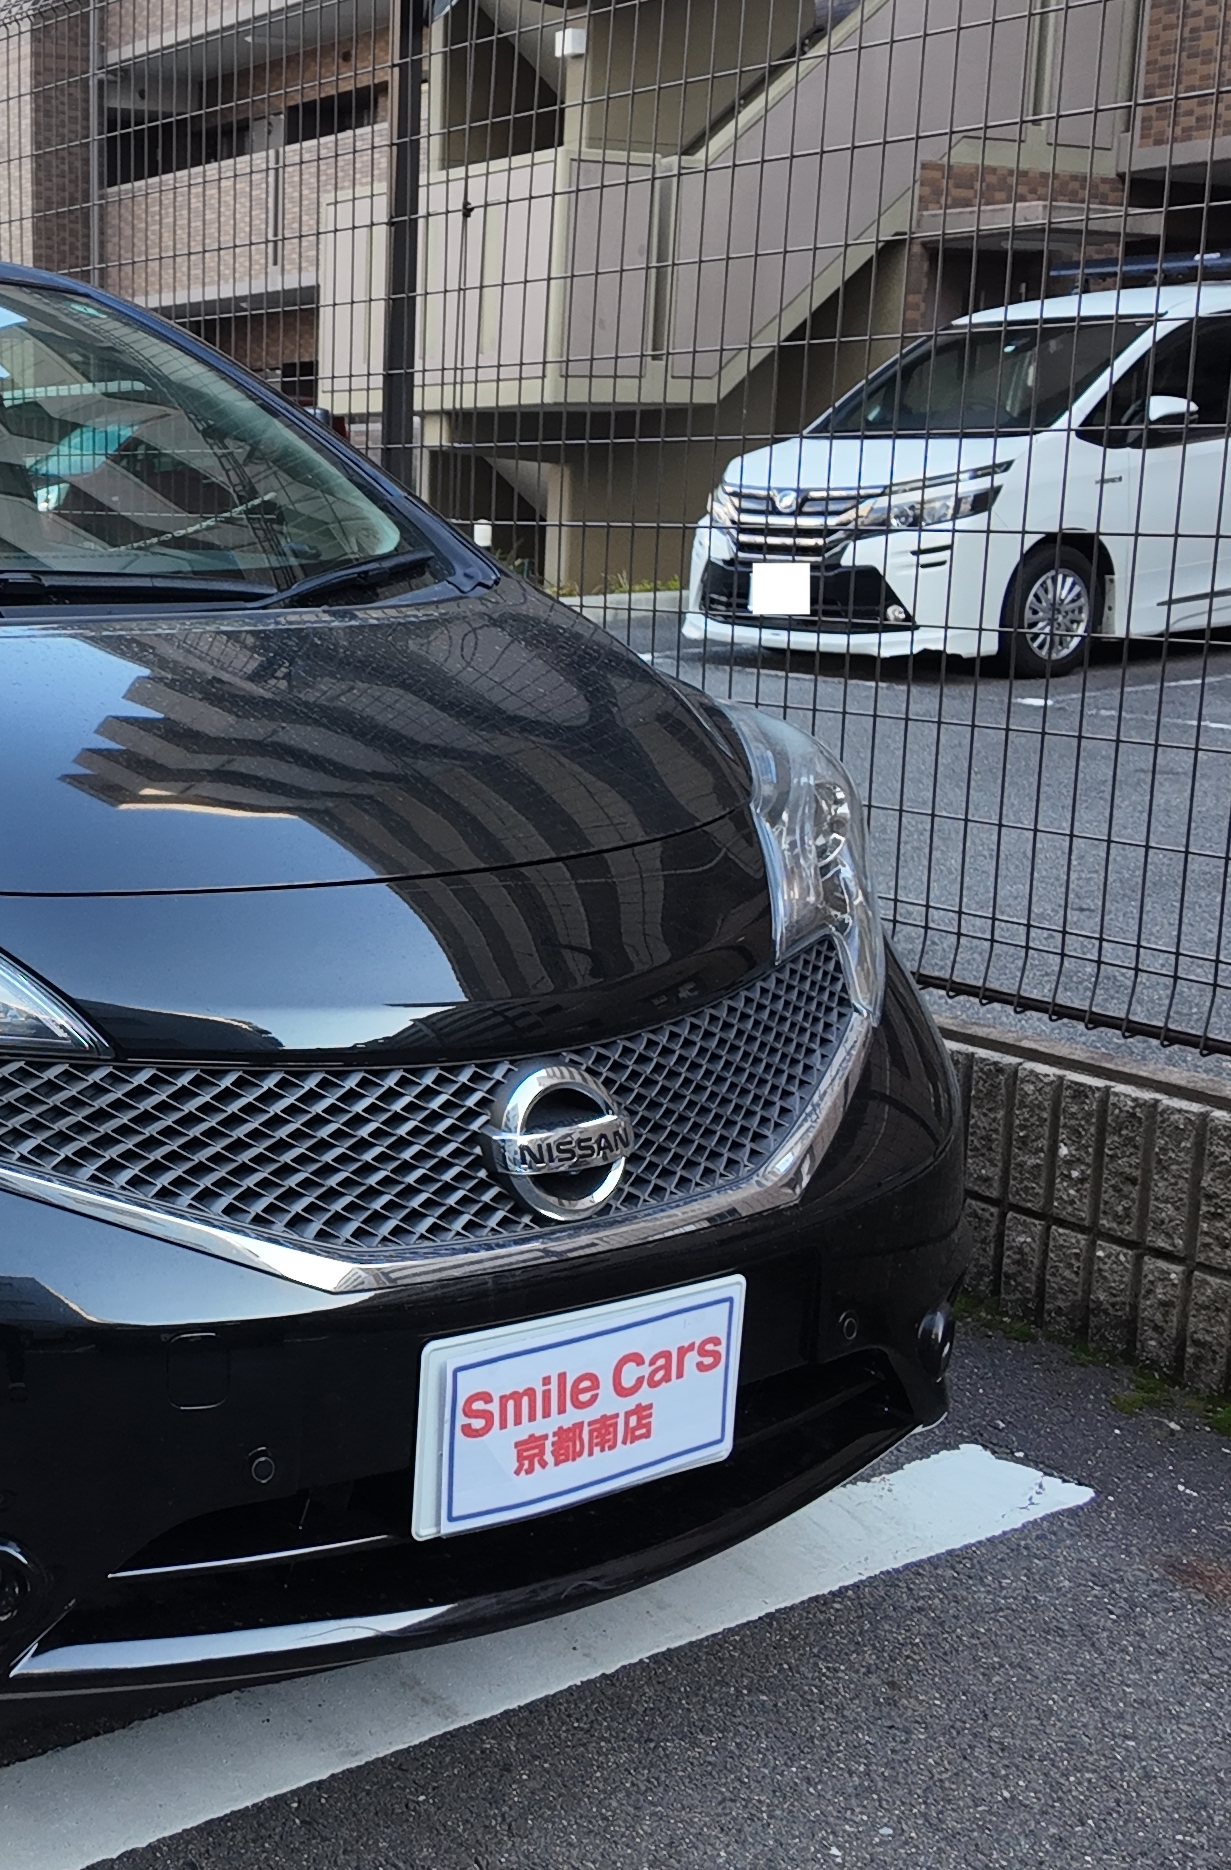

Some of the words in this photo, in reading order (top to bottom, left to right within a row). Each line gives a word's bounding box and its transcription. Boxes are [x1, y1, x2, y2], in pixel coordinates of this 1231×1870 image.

[518, 1126, 631, 1166] NISSAN
[460, 1371, 601, 1439] Smile
[612, 1335, 723, 1398] Cars
[513, 1402, 654, 1477] 京都南店
